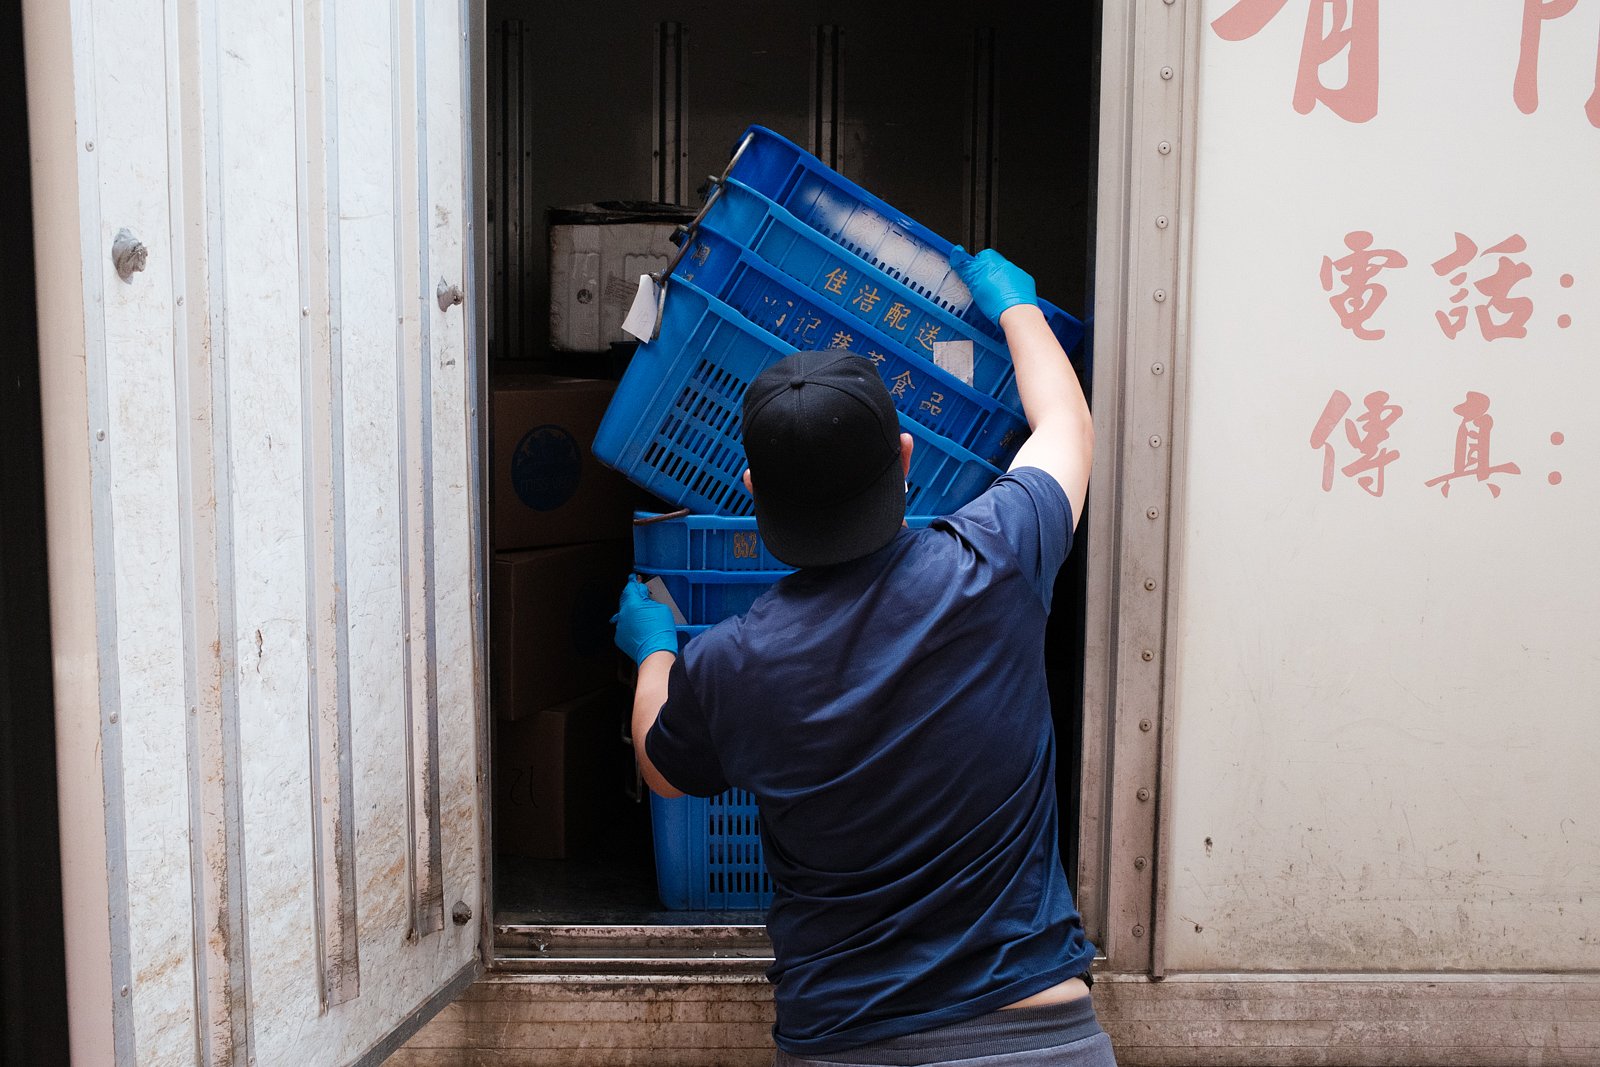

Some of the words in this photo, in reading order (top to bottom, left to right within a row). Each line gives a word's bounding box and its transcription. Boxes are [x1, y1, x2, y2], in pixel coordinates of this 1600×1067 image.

[824, 267, 942, 352] 佳洁配送
[1319, 230, 1574, 342] 電話:
[1310, 389, 1565, 498] 傳真:
